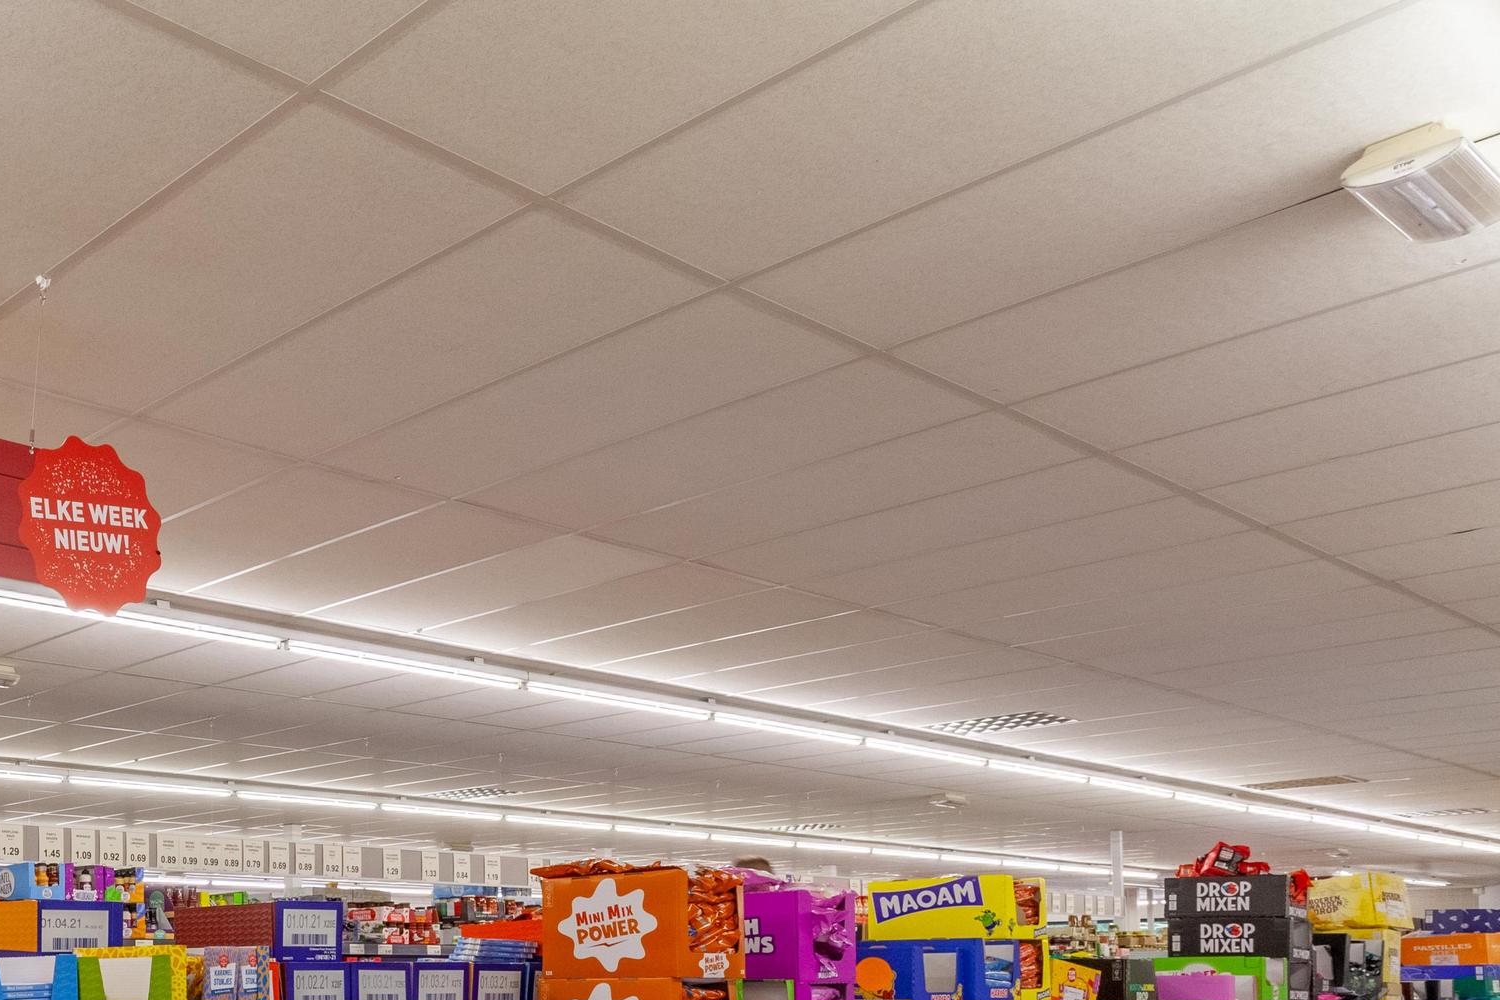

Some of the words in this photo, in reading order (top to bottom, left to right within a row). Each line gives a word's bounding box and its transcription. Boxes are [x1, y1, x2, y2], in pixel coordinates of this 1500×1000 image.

[30, 497, 84, 522] ELKE
[89, 503, 149, 530] WEEK
[54, 526, 131, 555] NIEUW!
[2, 846, 20, 856] 1.29
[43, 849, 61, 858] 1.45
[75, 851, 92, 860] 1.09
[103, 852, 120, 861] 0.92
[130, 853, 147, 863] 0.69
[160, 855, 177, 864] 0.89
[182, 856, 198, 865] 0.99
[203, 857, 219, 866] 0.99
[224, 858, 239, 868] 0.89
[246, 859, 261, 869] 0.79
[272, 861, 287, 870] 0.69
[298, 863, 313, 871] 0.89
[325, 864, 339, 872] 0.92
[346, 865, 359, 873] 1.59
[386, 867, 399, 875] 1.29
[1196, 881, 1252, 897] DROP
[880, 879, 977, 919] MAOAM
[1196, 897, 1250, 912] MIXEN
[575, 911, 605, 927] MINI
[607, 904, 634, 920] MIX
[1313, 906, 1339, 915] DROP
[41, 917, 82, 929] 01.04.21
[286, 913, 321, 929] 01.01.21
[576, 918, 641, 945] POWER
[1200, 923, 1256, 939] DROP
[1200, 938, 1255, 953] MIXEN
[1412, 942, 1472, 951] PASTILLES
[704, 962, 725, 972] POWER
[295, 974, 329, 990] 01.02.21
[420, 973, 450, 989] 01.03.21
[480, 973, 508, 989] 01.03.21
[990, 988, 1009, 998] HARIBO
